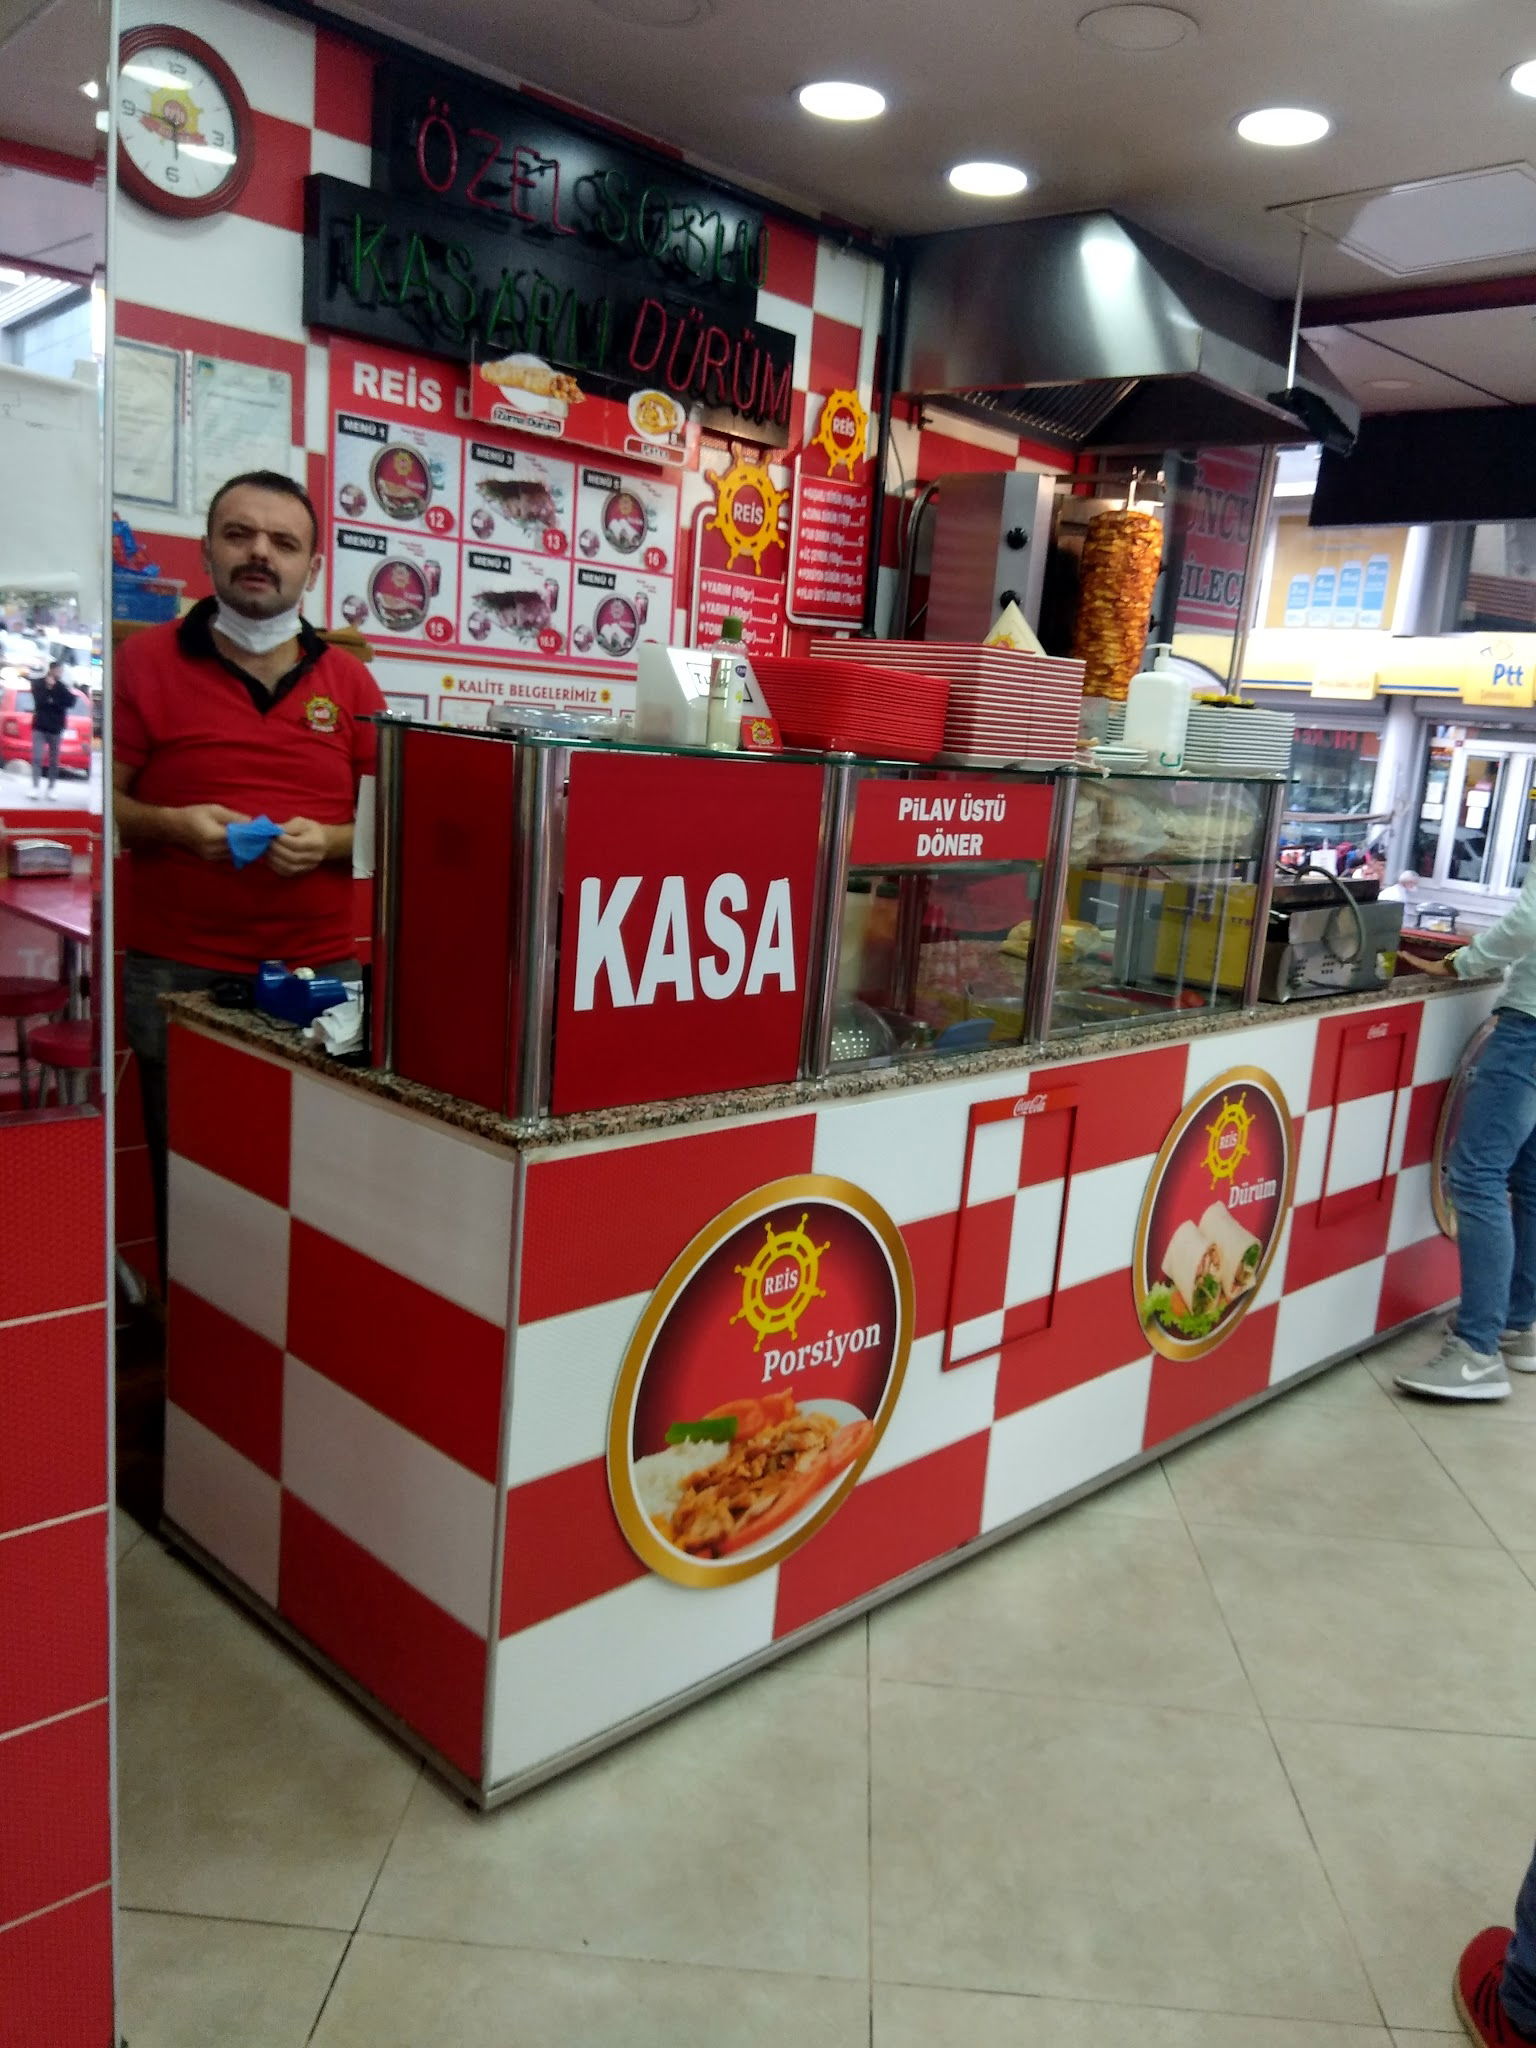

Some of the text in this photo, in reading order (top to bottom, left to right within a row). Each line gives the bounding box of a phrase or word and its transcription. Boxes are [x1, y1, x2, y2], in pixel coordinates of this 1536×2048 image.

[166, 166, 180, 184] 6
[416, 96, 578, 236] ÖZEL
[628, 298, 792, 427] DÜRÜM
[352, 359, 443, 414] REİS
[429, 511, 445, 529] 12
[733, 501, 764, 526] REİS
[546, 534, 560, 550] 13
[429, 622, 444, 638] 15
[1492, 663, 1525, 687] Ptt
[458, 678, 597, 703] KALİTE BELGELERİMİZ
[960, 793, 1006, 823] ÜSTÜ
[916, 828, 984, 858] DÖNER
[573, 872, 797, 1012] KASA
[1228, 1177, 1277, 1209] Dürüm
[764, 1267, 799, 1296] REİS
[761, 1322, 881, 1383] Porsiyon
